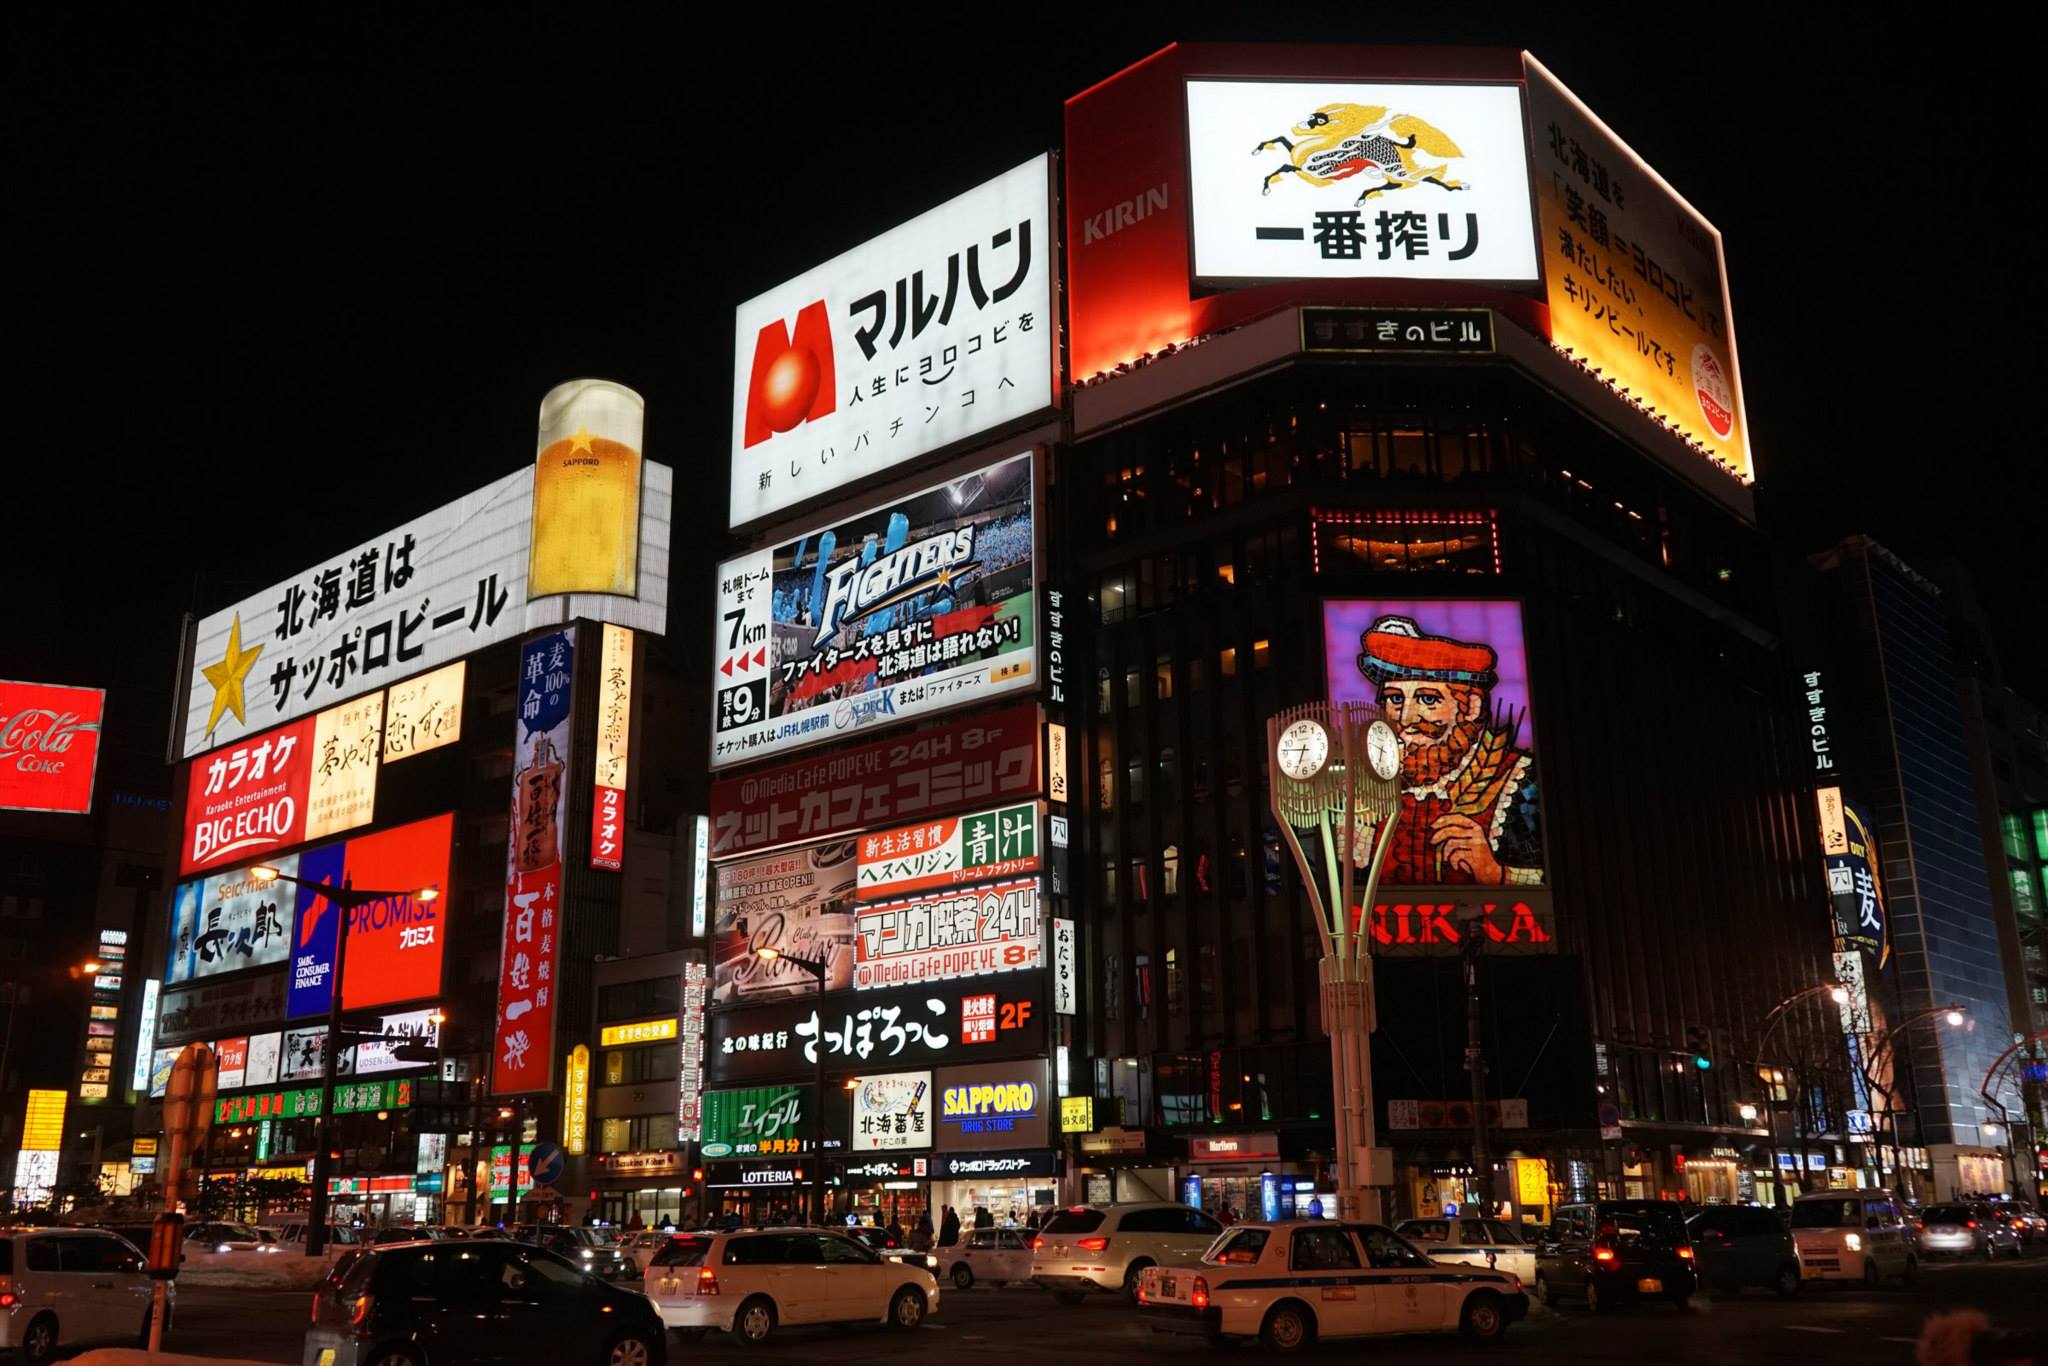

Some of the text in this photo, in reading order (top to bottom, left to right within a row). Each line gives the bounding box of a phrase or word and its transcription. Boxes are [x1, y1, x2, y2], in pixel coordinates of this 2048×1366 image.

[1082, 182, 1170, 246] KIRIN
[1256, 210, 1480, 261] 一番搾り
[850, 218, 1032, 362] マルハン
[850, 311, 1034, 407] 人生にヨロコビを
[757, 376, 1015, 491] 新しいパチンコへ
[562, 457, 601, 468] SAPPORO
[275, 533, 416, 641] 北海道は
[722, 566, 770, 595] 札幌ドーム
[737, 588, 755, 604] まで
[813, 522, 976, 650] FIGHTERS
[270, 573, 509, 712] サッポロビール
[782, 618, 933, 684] ファイターズを見ずに
[523, 651, 545, 720] 革命
[723, 691, 733, 729] 地下鉄
[17, 753, 65, 774] Coke
[204, 735, 297, 796] カラオケ
[827, 750, 883, 784] POPEYE
[889, 735, 951, 768] 24H
[205, 799, 233, 816] Karaoke
[235, 781, 288, 808] Entertainment
[193, 816, 233, 862] BIG
[235, 795, 296, 837] ECHO
[600, 789, 618, 856] カラオケ
[865, 824, 944, 859] 新生活習慣
[965, 812, 1033, 865] 青汁
[860, 850, 960, 882] ヘスペリジン
[952, 859, 1035, 883] ドリーム ファクトリー
[400, 924, 436, 950] プロミス
[536, 882, 556, 1009] 本格麦焼酎
[295, 975, 323, 990] FINANCE
[296, 961, 331, 977] CONSUMER
[503, 890, 542, 1072] 百姓一揆
[873, 944, 1038, 983] Media Cafe POPEYE 8F
[722, 997, 1032, 1065] 北の味紀行 さっぽろっこ 2F
[573, 1069, 586, 1152] すすきの交番
[738, 1098, 802, 1138] エイブル
[943, 1082, 1036, 1116] SAPPORO
[860, 1111, 926, 1135] 北海番屋
[960, 1118, 1015, 1134] DRUG STORE
[1209, 1140, 1238, 1152] Marlboro
[742, 1169, 794, 1184] LOTTERIA
